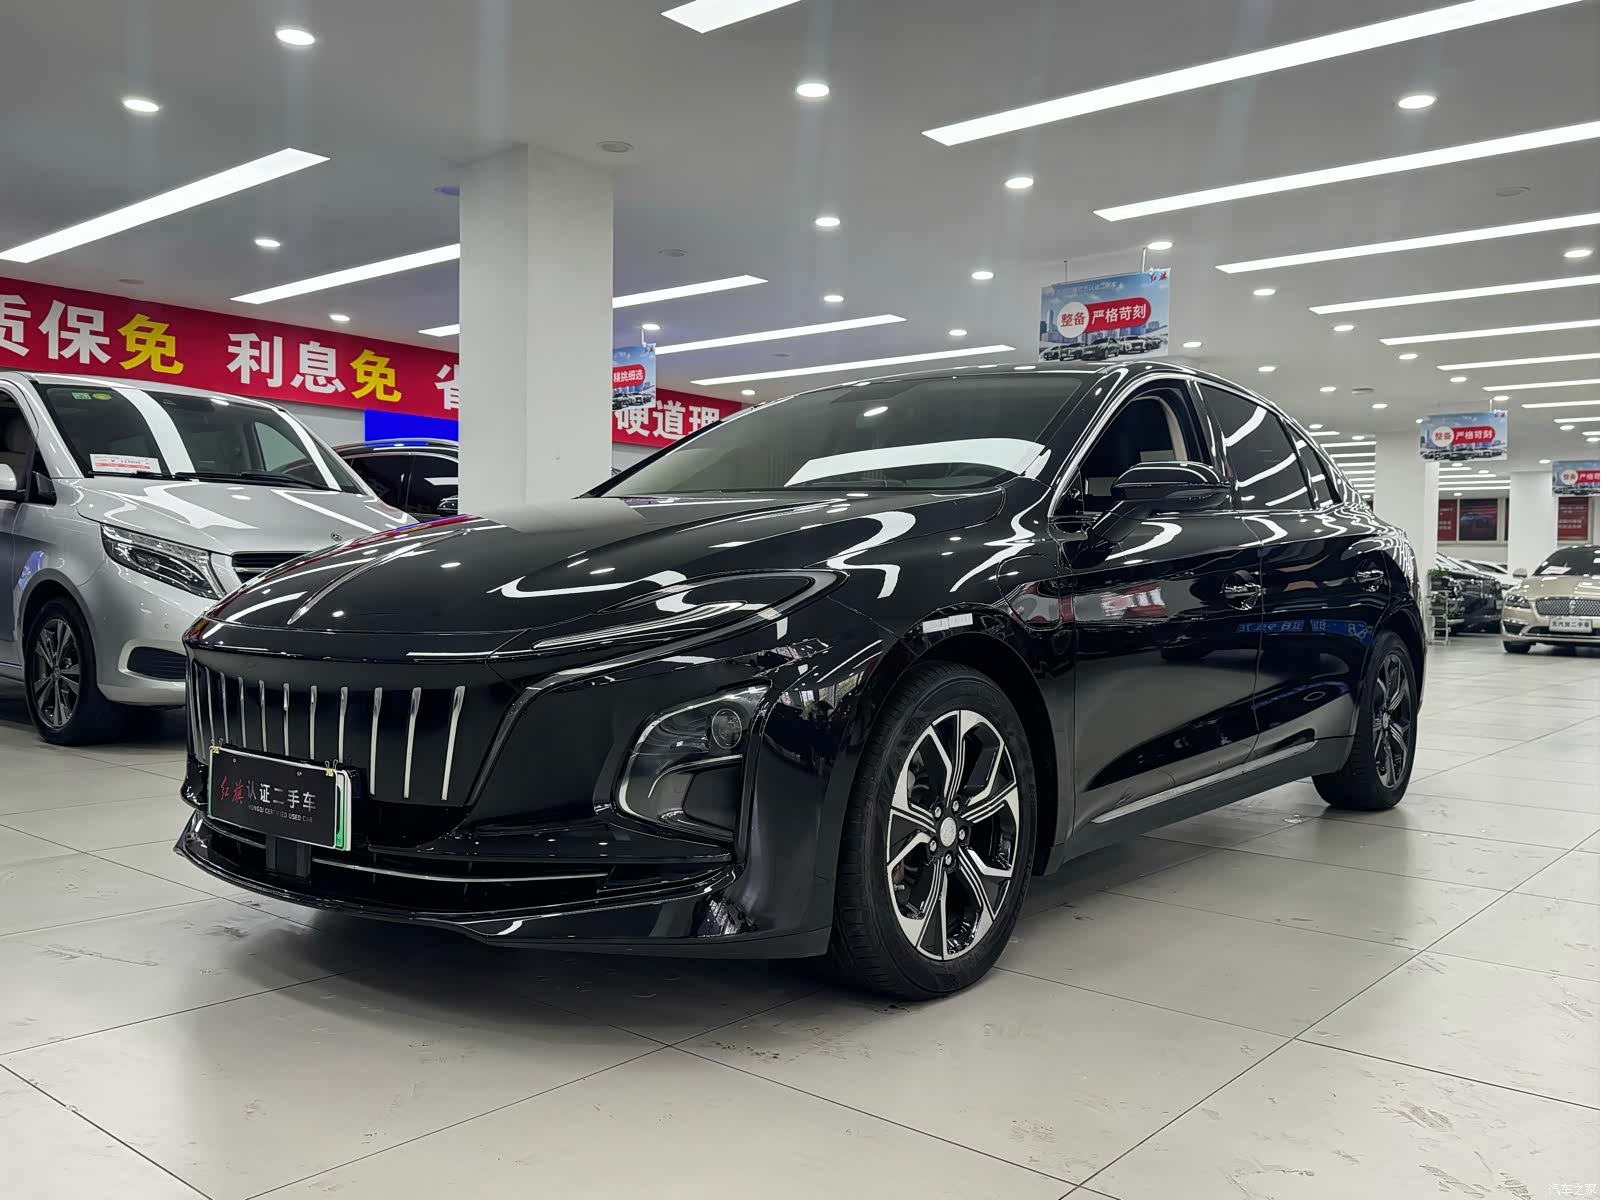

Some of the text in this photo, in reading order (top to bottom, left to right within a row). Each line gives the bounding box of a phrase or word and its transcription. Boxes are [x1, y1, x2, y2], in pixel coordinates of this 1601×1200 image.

[1060, 303, 1146, 327] 整备 严格苛刻
[226, 331, 402, 403] 利息免
[613, 368, 644, 383] 精挑细选
[612, 400, 720, 440] 硬道理
[220, 775, 317, 812] 红旗认证二手车
[288, 813, 301, 821] USED
